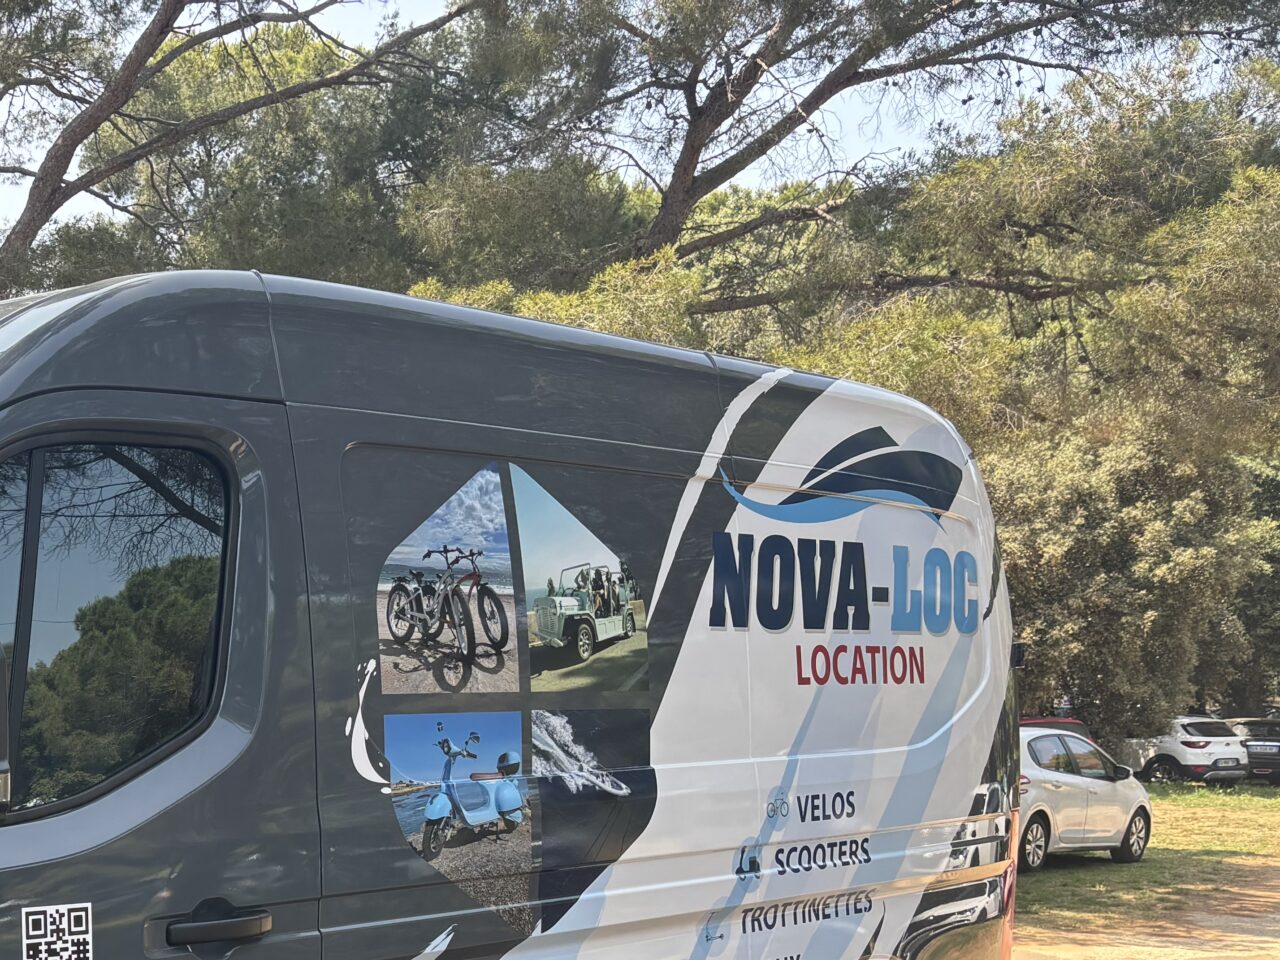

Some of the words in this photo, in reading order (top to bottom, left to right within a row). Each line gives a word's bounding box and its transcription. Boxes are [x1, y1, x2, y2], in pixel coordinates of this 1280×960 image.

[708, 532, 979, 636] NOVA-LOC
[795, 645, 925, 685] LOCATION
[797, 791, 856, 823] VELOS
[774, 837, 872, 875] SCOOTERS
[741, 887, 873, 934] TROTTINETTES
